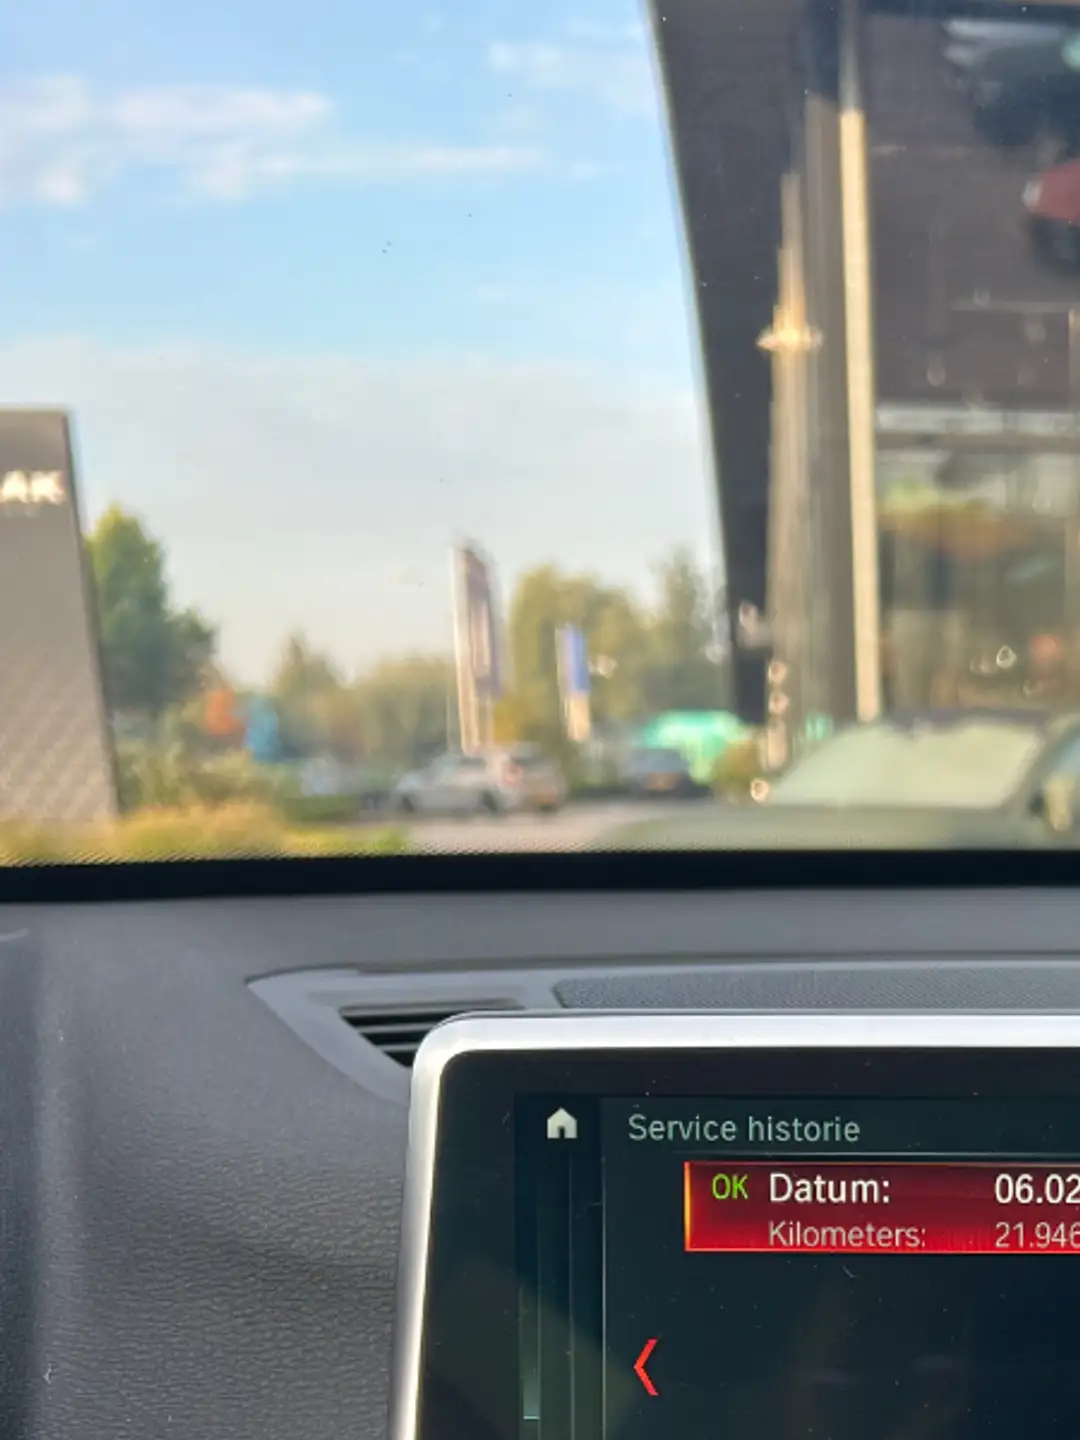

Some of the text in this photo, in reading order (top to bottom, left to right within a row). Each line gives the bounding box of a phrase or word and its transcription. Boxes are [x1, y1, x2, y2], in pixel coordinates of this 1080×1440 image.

[627, 1113, 861, 1142] Service historie
[711, 1174, 749, 1200] OK
[769, 1173, 891, 1204] Datum:
[768, 1221, 926, 1249] Kilometers:
